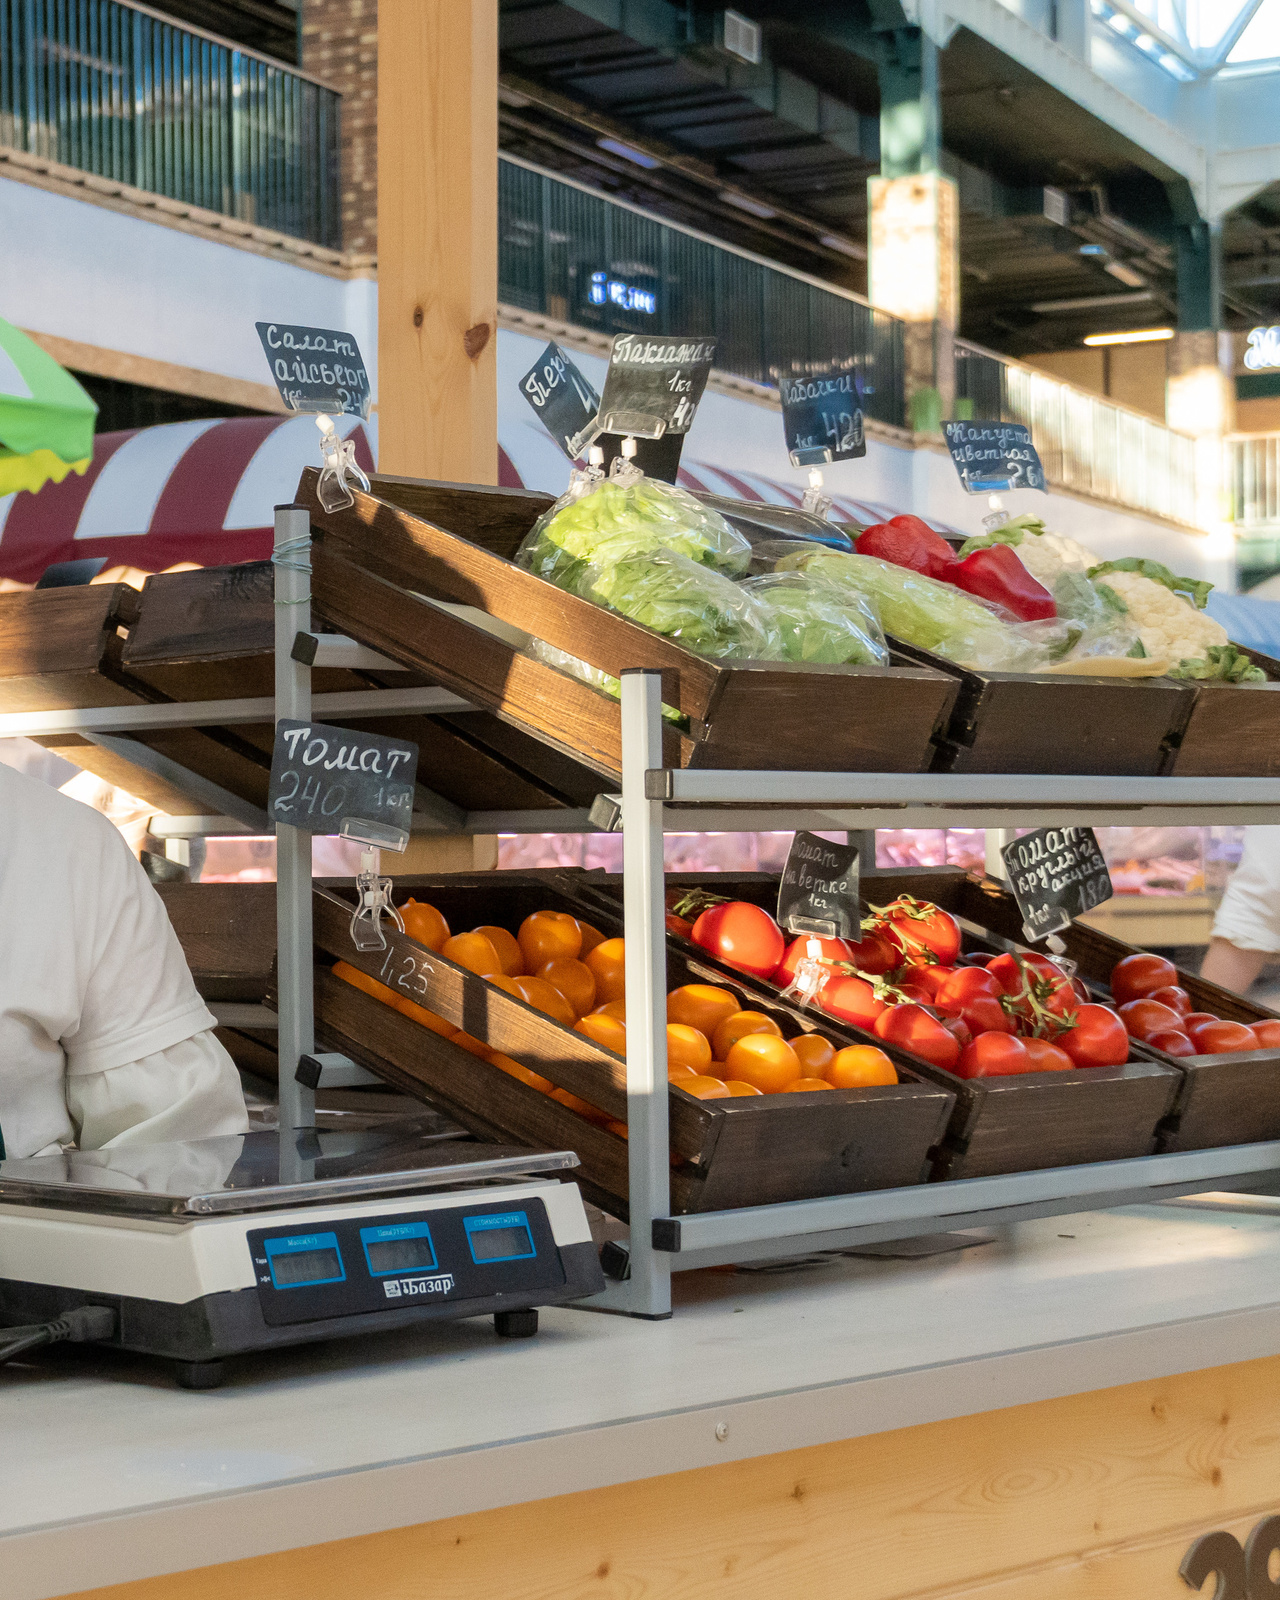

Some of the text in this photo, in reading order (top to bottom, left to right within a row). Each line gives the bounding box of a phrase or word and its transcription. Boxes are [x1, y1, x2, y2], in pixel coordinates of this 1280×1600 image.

[267, 325, 355, 356] Салат
[337, 388, 364, 412] 24
[946, 423, 1033, 449] Капуста
[284, 727, 412, 779] Томат
[274, 770, 348, 815] 240
[1004, 827, 1087, 876] Томат
[1017, 838, 1095, 894] круглый
[799, 864, 848, 894] ветке
[381, 946, 435, 994] 1,25
